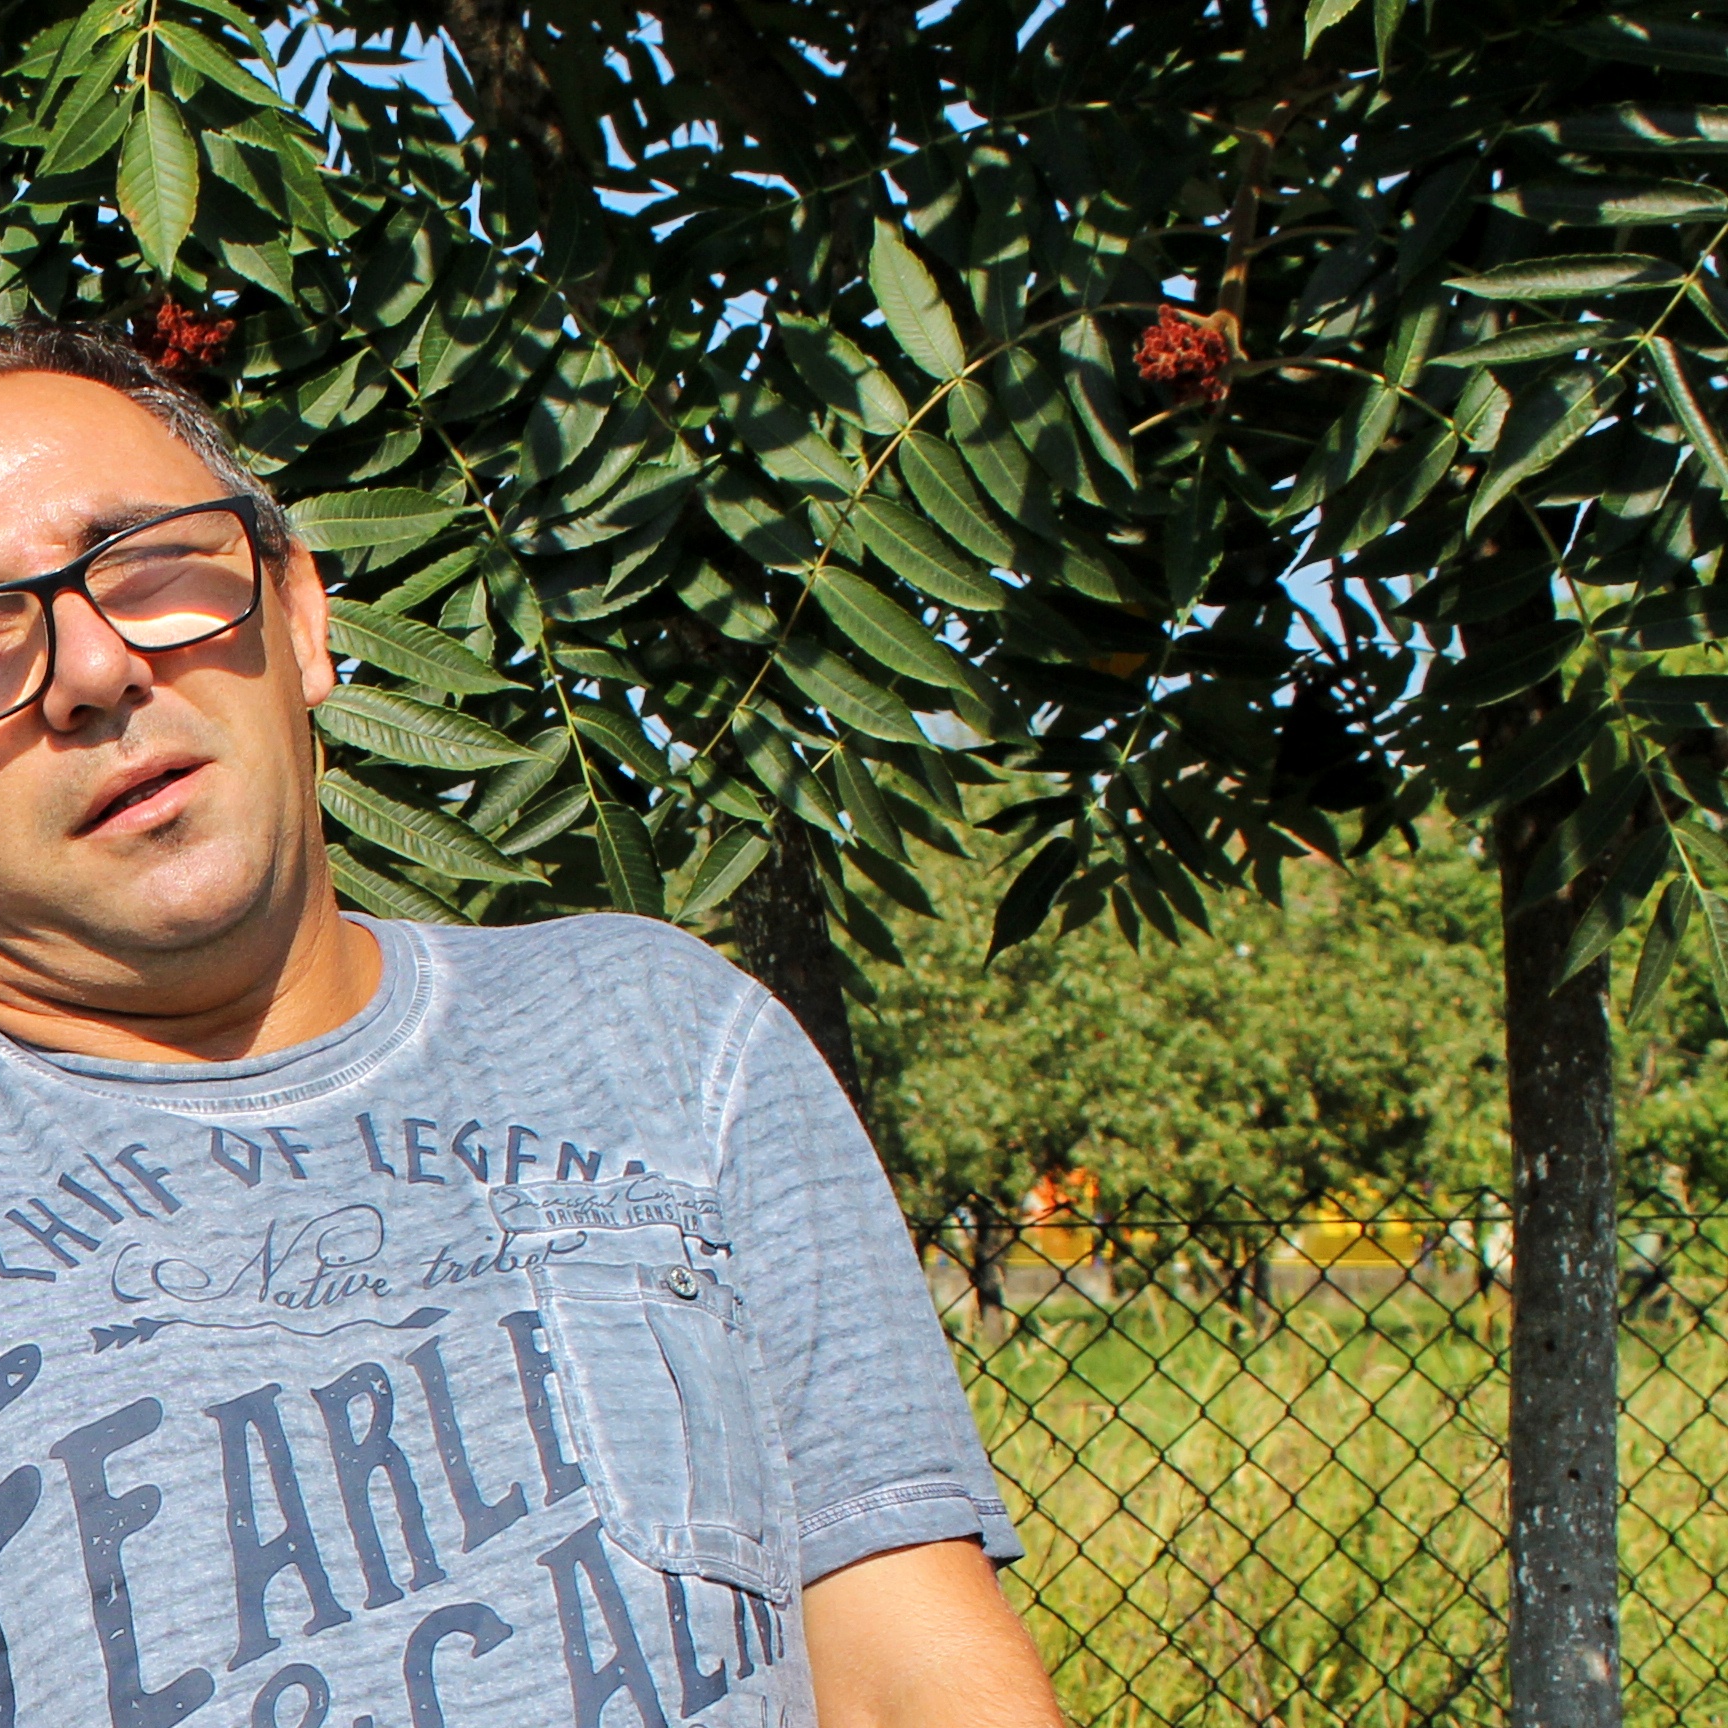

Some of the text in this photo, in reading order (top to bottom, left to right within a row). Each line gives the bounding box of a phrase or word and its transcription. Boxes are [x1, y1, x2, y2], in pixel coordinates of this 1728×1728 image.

[211, 1126, 311, 1188] OF
[355, 1112, 645, 1184] LEGEN
[545, 1208, 620, 1226] ORIGINAL
[626, 1203, 675, 1224] JEANS
[149, 1204, 393, 1309] Native
